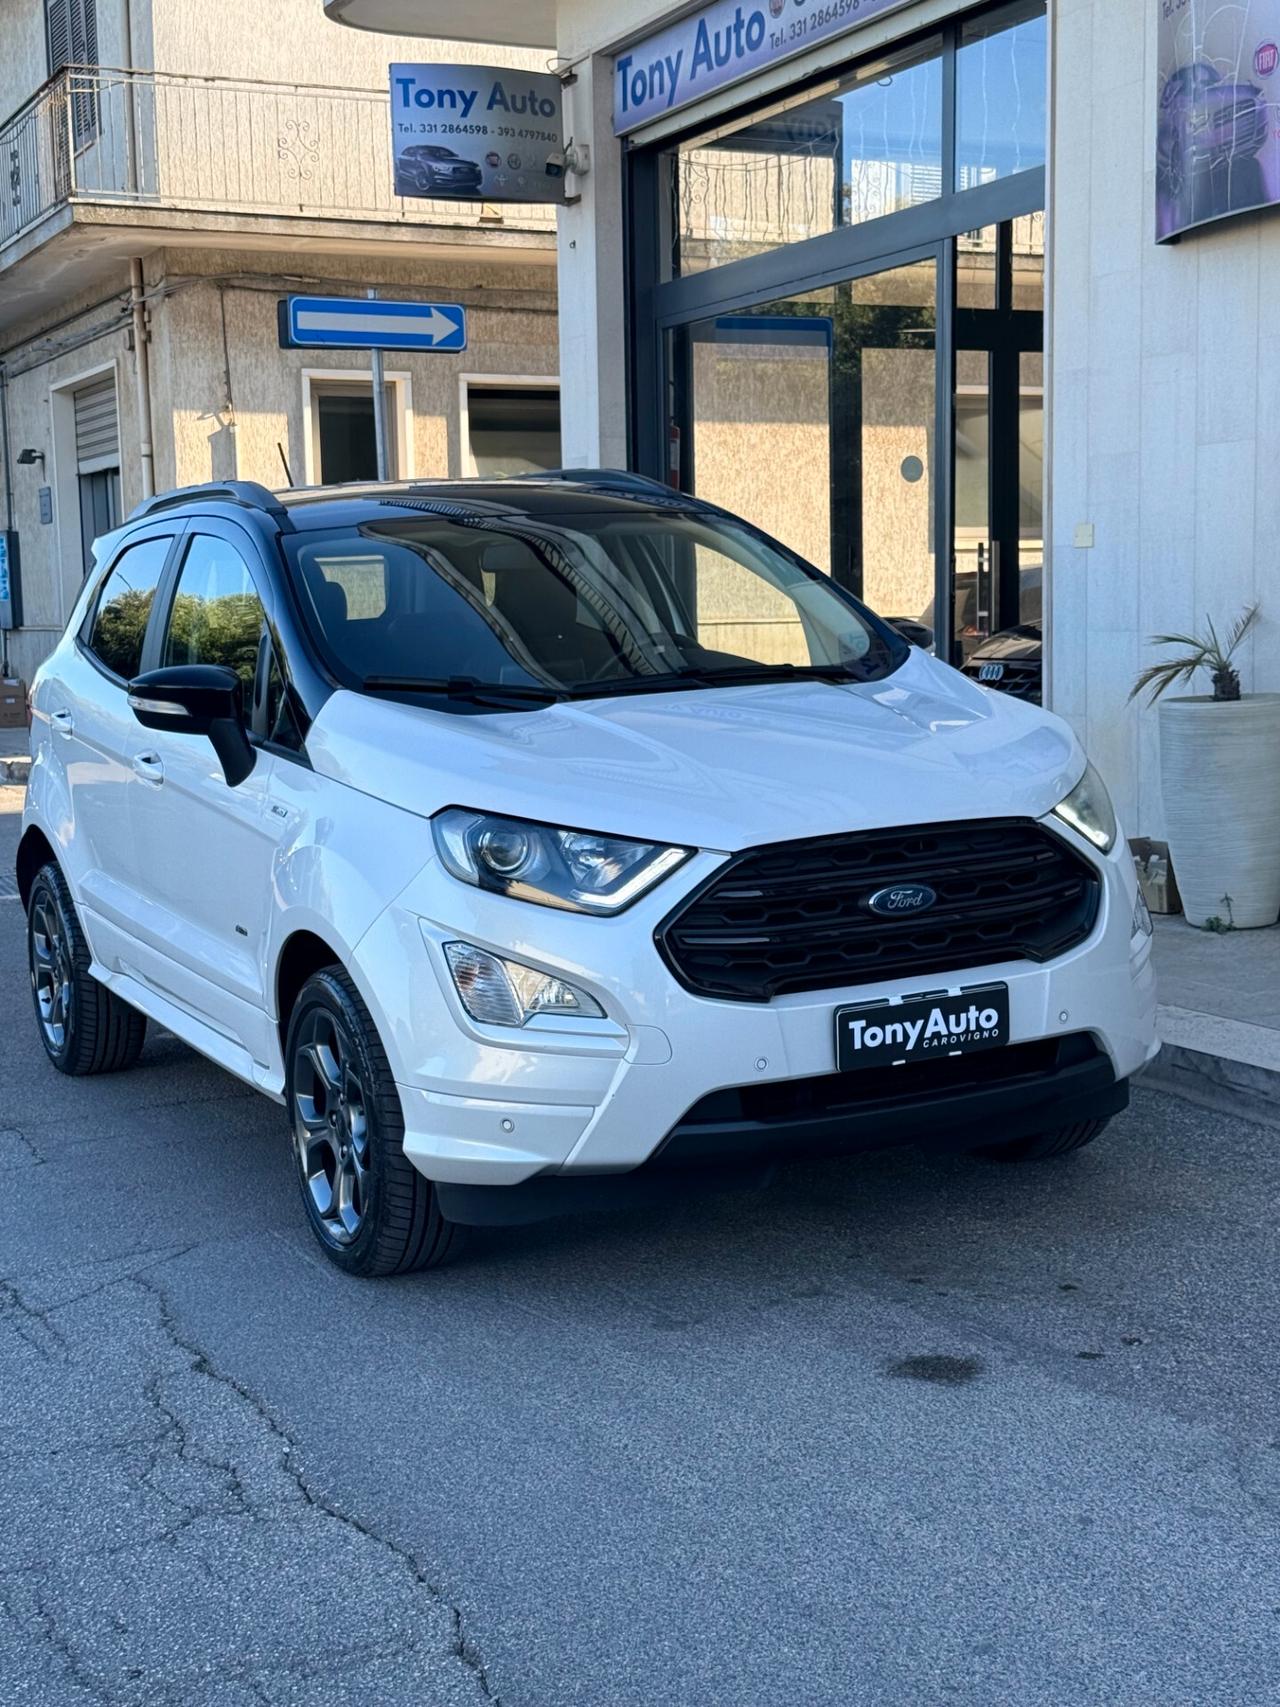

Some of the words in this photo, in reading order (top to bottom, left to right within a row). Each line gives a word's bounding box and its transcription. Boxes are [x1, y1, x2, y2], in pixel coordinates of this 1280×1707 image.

[769, 28, 786, 49] Tel.
[789, 18, 807, 40] 331
[617, 49, 683, 112] Tony
[690, 7, 765, 80] Auto
[396, 78, 478, 118] Tony
[486, 82, 556, 118] Auto
[398, 123, 415, 133] Tel.
[419, 124, 437, 134] 331
[441, 124, 488, 135] 2864598
[497, 126, 516, 138] 393
[887, 890, 923, 909] Ford
[923, 1028, 999, 1048] CAROVIGNO
